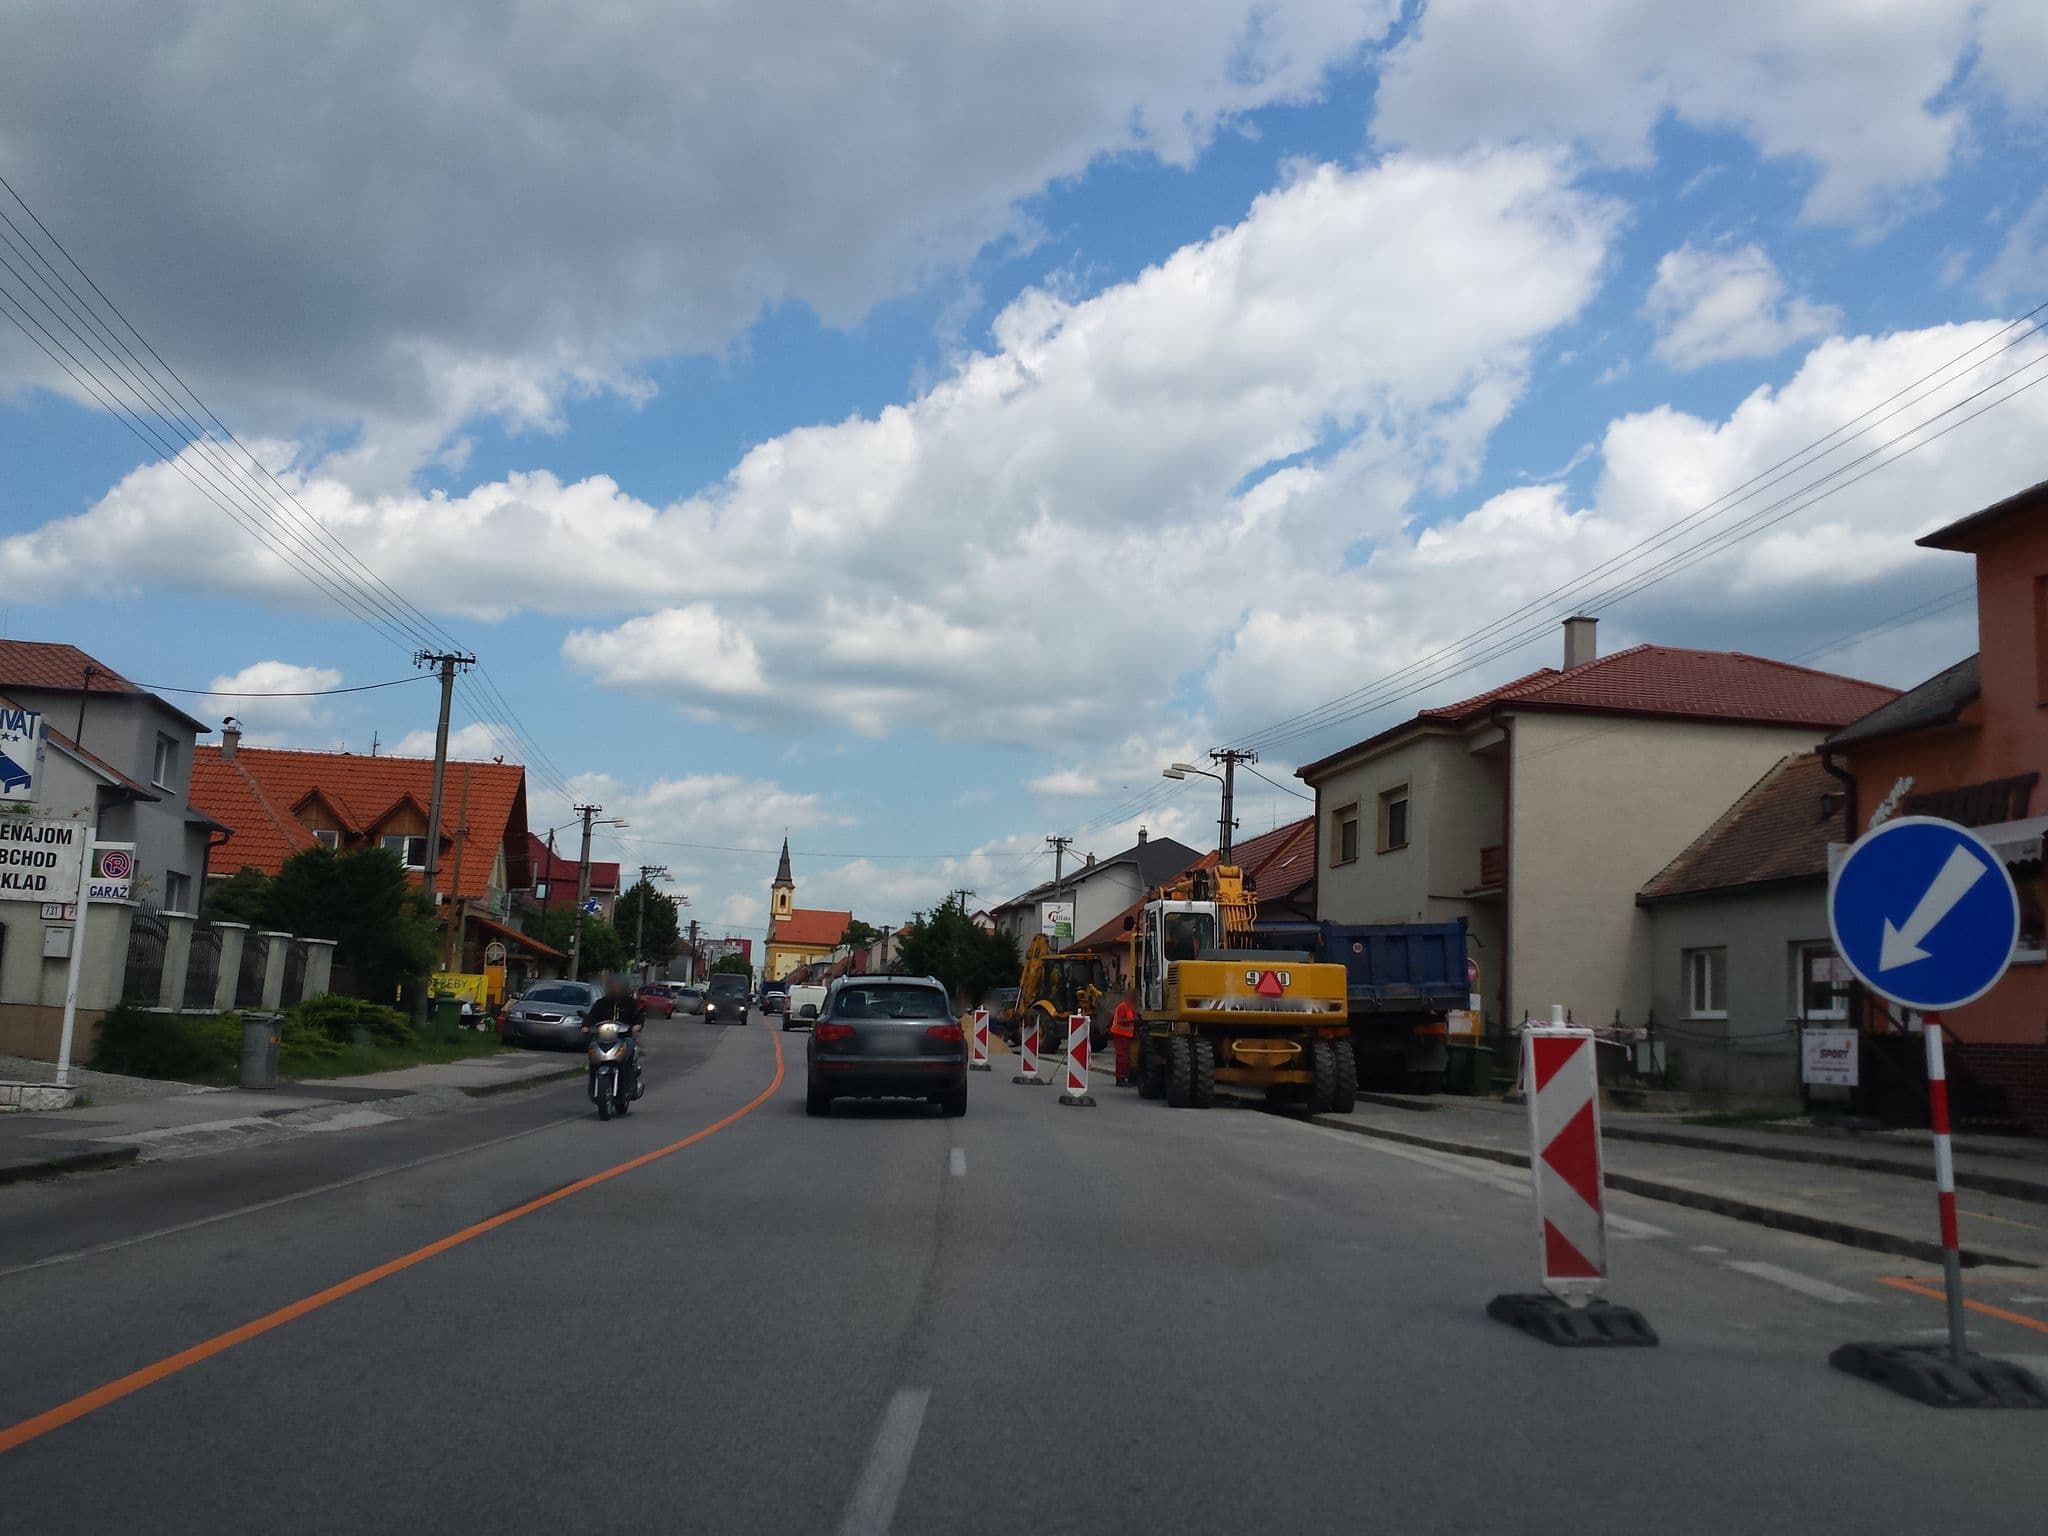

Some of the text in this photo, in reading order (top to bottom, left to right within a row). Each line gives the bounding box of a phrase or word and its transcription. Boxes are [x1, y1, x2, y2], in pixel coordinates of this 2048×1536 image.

[0, 872, 47, 891] KLAD
[90, 884, 128, 897] GARAŽ
[1245, 970, 1291, 987] 90
